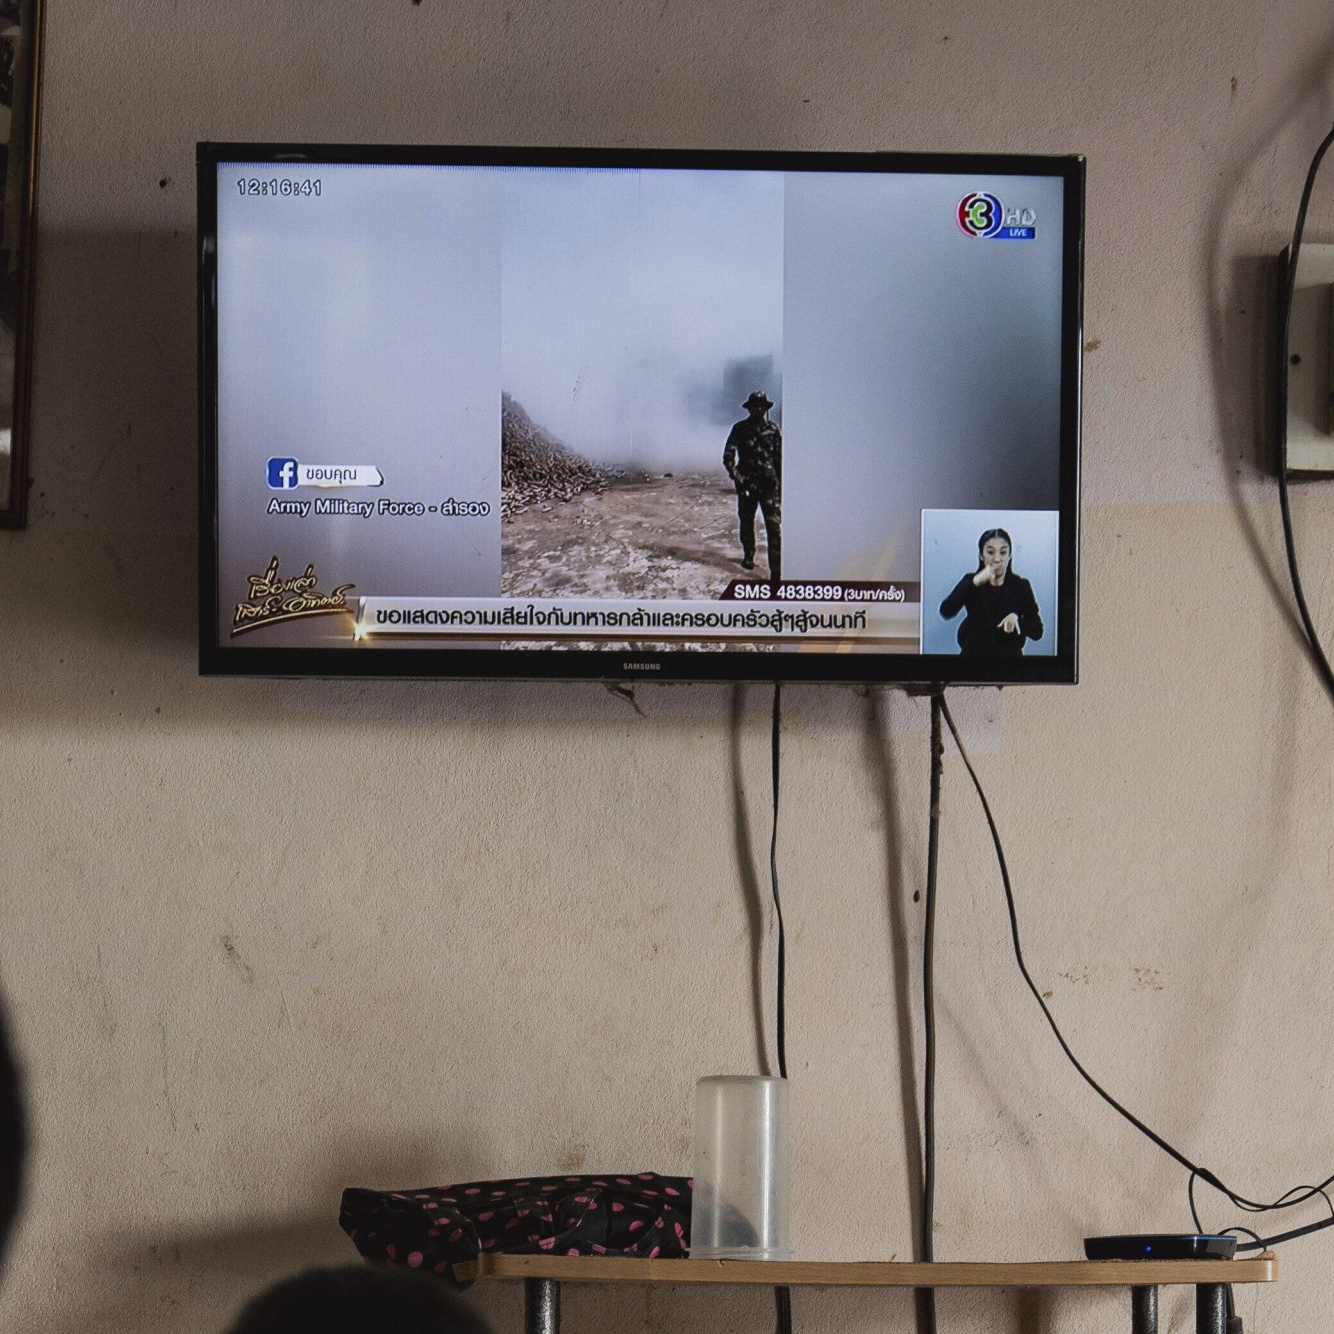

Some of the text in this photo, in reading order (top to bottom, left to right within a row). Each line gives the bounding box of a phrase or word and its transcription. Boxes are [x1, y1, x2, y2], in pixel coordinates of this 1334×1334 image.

[237, 178, 322, 196] 12:16:41
[1006, 208, 1036, 226] HD
[1009, 228, 1027, 237] LIVE
[306, 468, 357, 485] ขอบคุณ
[267, 498, 310, 517] Army
[316, 498, 374, 518] Military
[378, 498, 425, 516] Force
[441, 498, 491, 517] สำรอง
[734, 584, 771, 599] SMS
[776, 584, 842, 600] 4838399
[623, 662, 661, 671] SAMSUNG
